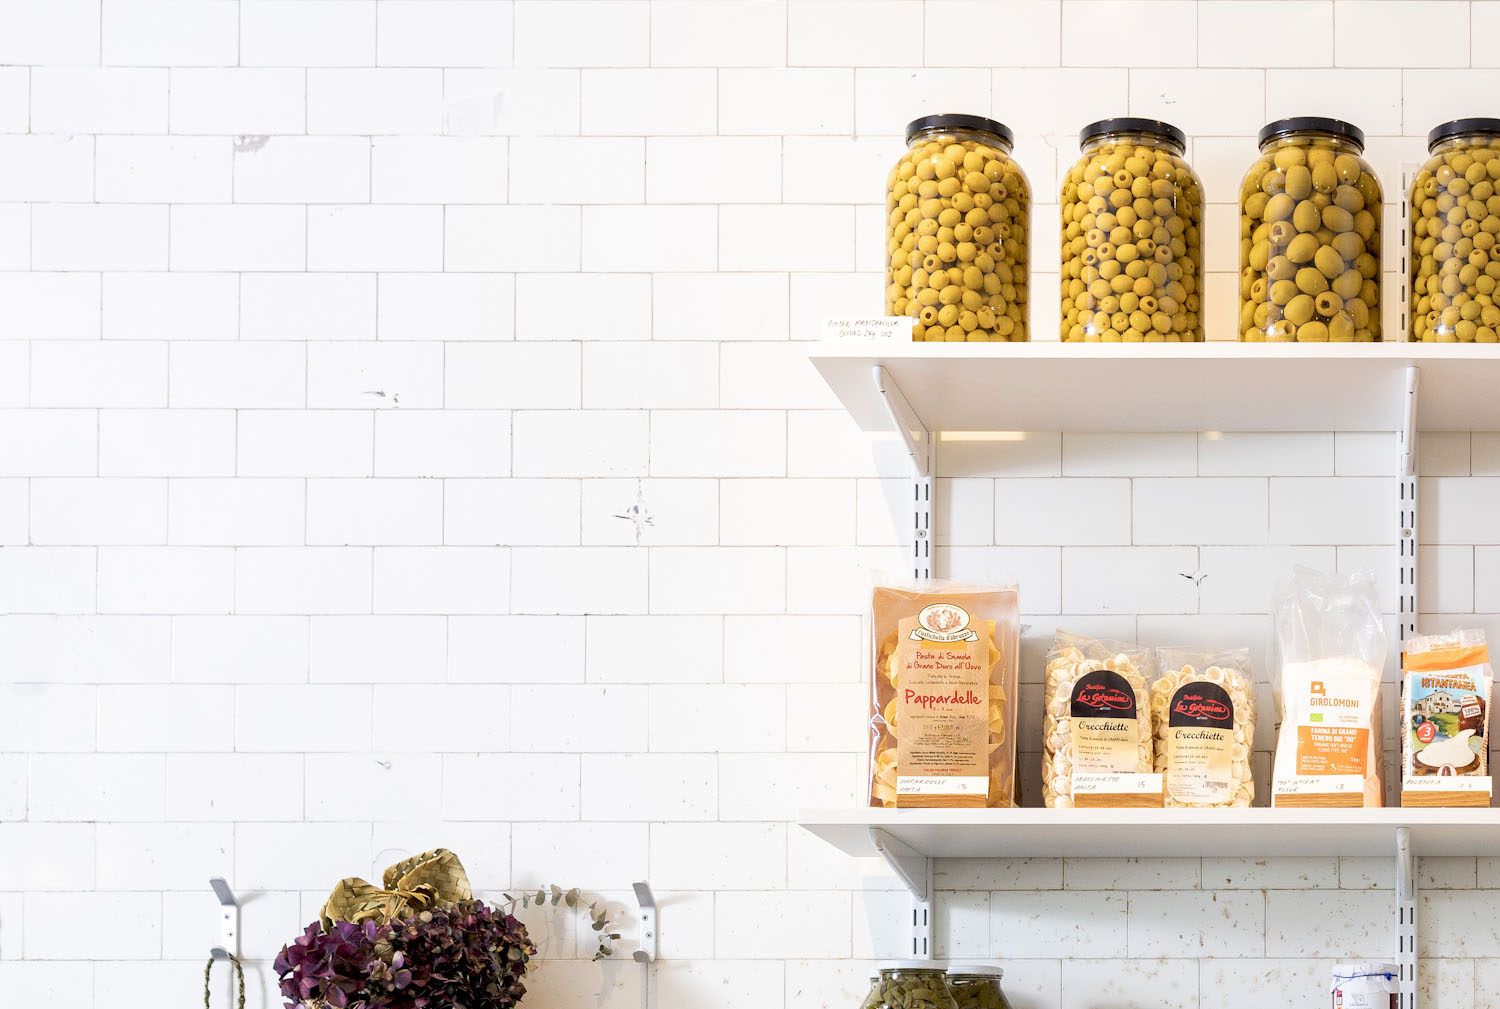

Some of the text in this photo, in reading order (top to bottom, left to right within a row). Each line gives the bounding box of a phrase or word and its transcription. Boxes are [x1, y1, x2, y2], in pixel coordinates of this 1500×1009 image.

[904, 688, 982, 710] Pappardelle
[1310, 698, 1360, 708] GIROLOMONI
[1078, 720, 1129, 732] Orecchiette
[1424, 726, 1432, 737] 3
[1175, 730, 1225, 741] Orecchiette
